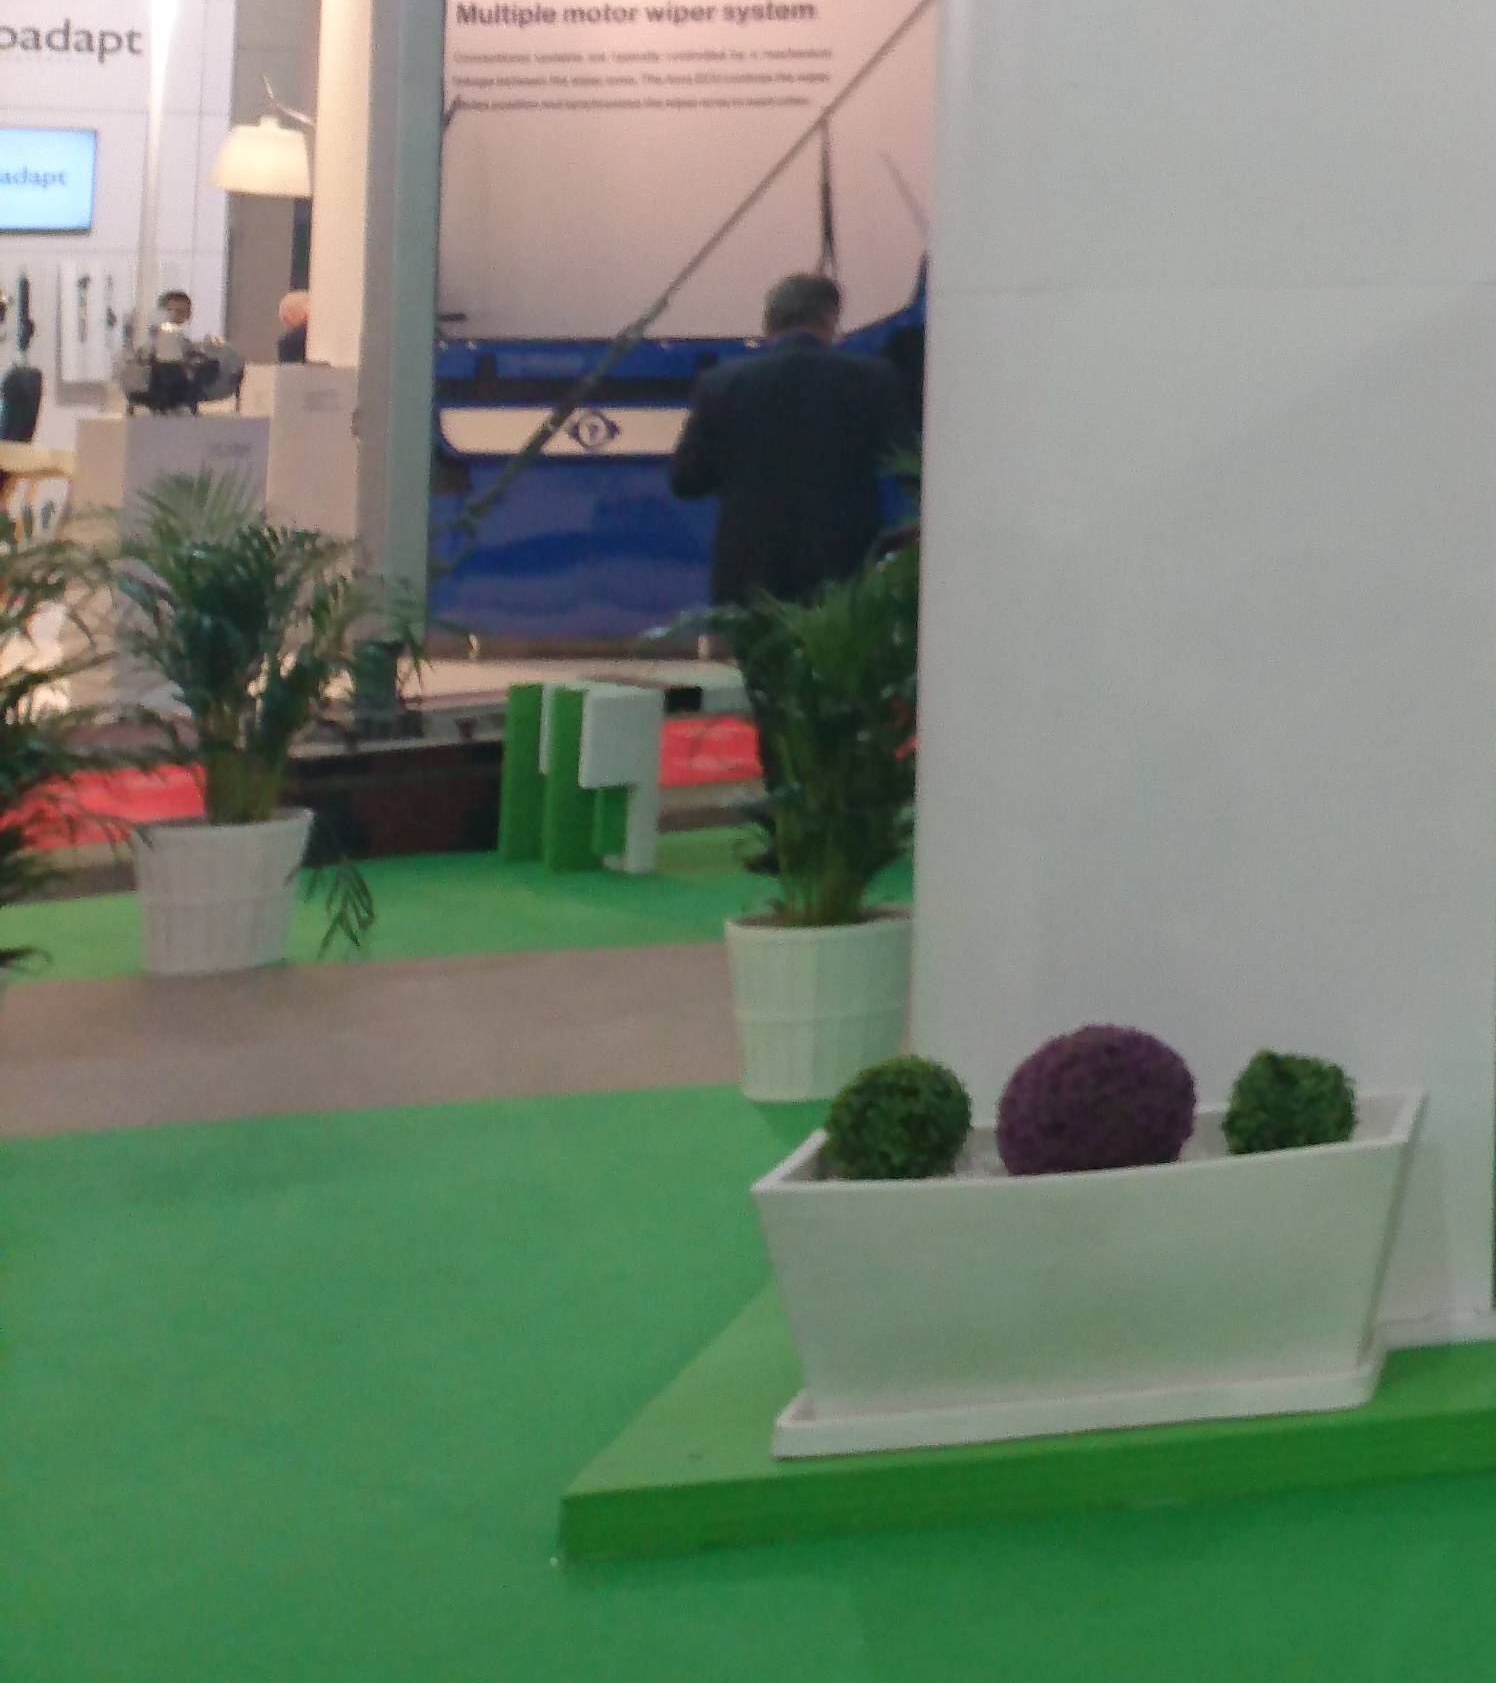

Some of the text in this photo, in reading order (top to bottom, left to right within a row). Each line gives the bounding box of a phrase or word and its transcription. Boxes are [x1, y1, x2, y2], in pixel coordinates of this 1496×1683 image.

[456, 0, 817, 28] Multiple motor wiper system
